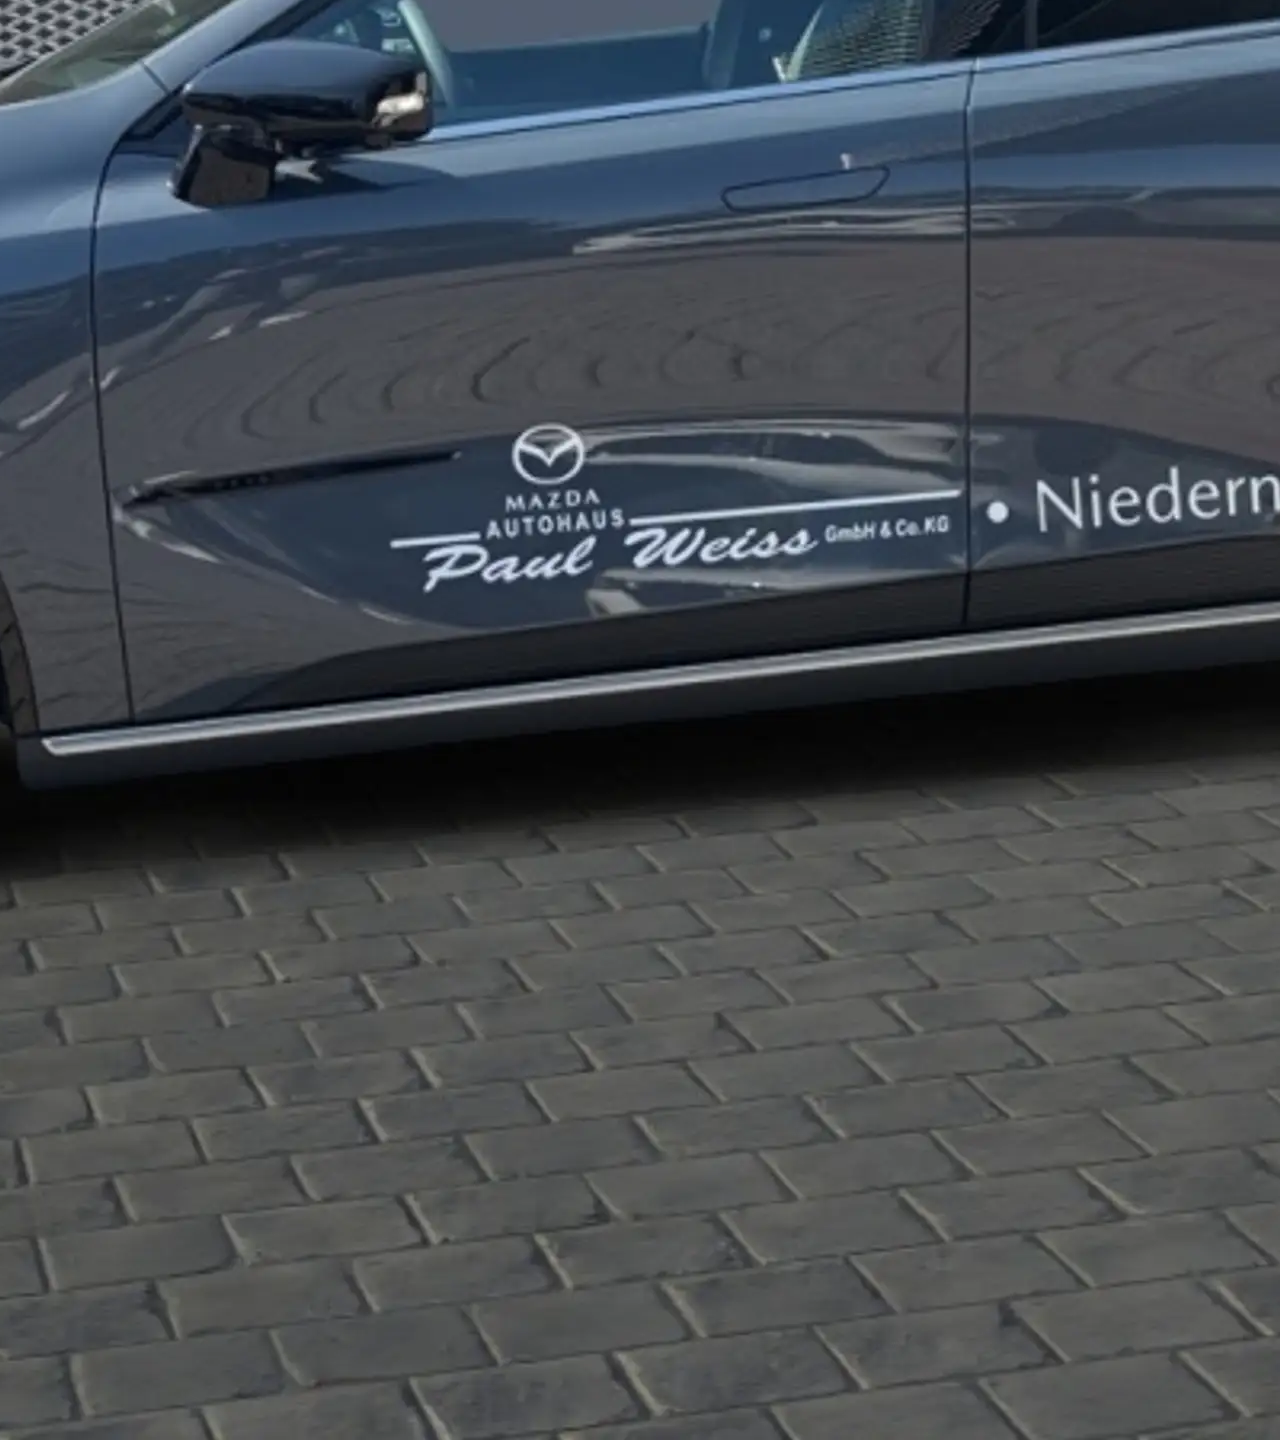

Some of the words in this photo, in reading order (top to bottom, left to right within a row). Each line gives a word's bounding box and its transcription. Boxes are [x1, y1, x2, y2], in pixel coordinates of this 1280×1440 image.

[505, 488, 600, 513] MAZDA
[486, 508, 624, 540] AUTOHAUS
[422, 535, 596, 592] Paul
[623, 525, 819, 568] Weiss
[824, 521, 876, 544] GmbH
[879, 519, 893, 539] &
[924, 514, 950, 535] KG
